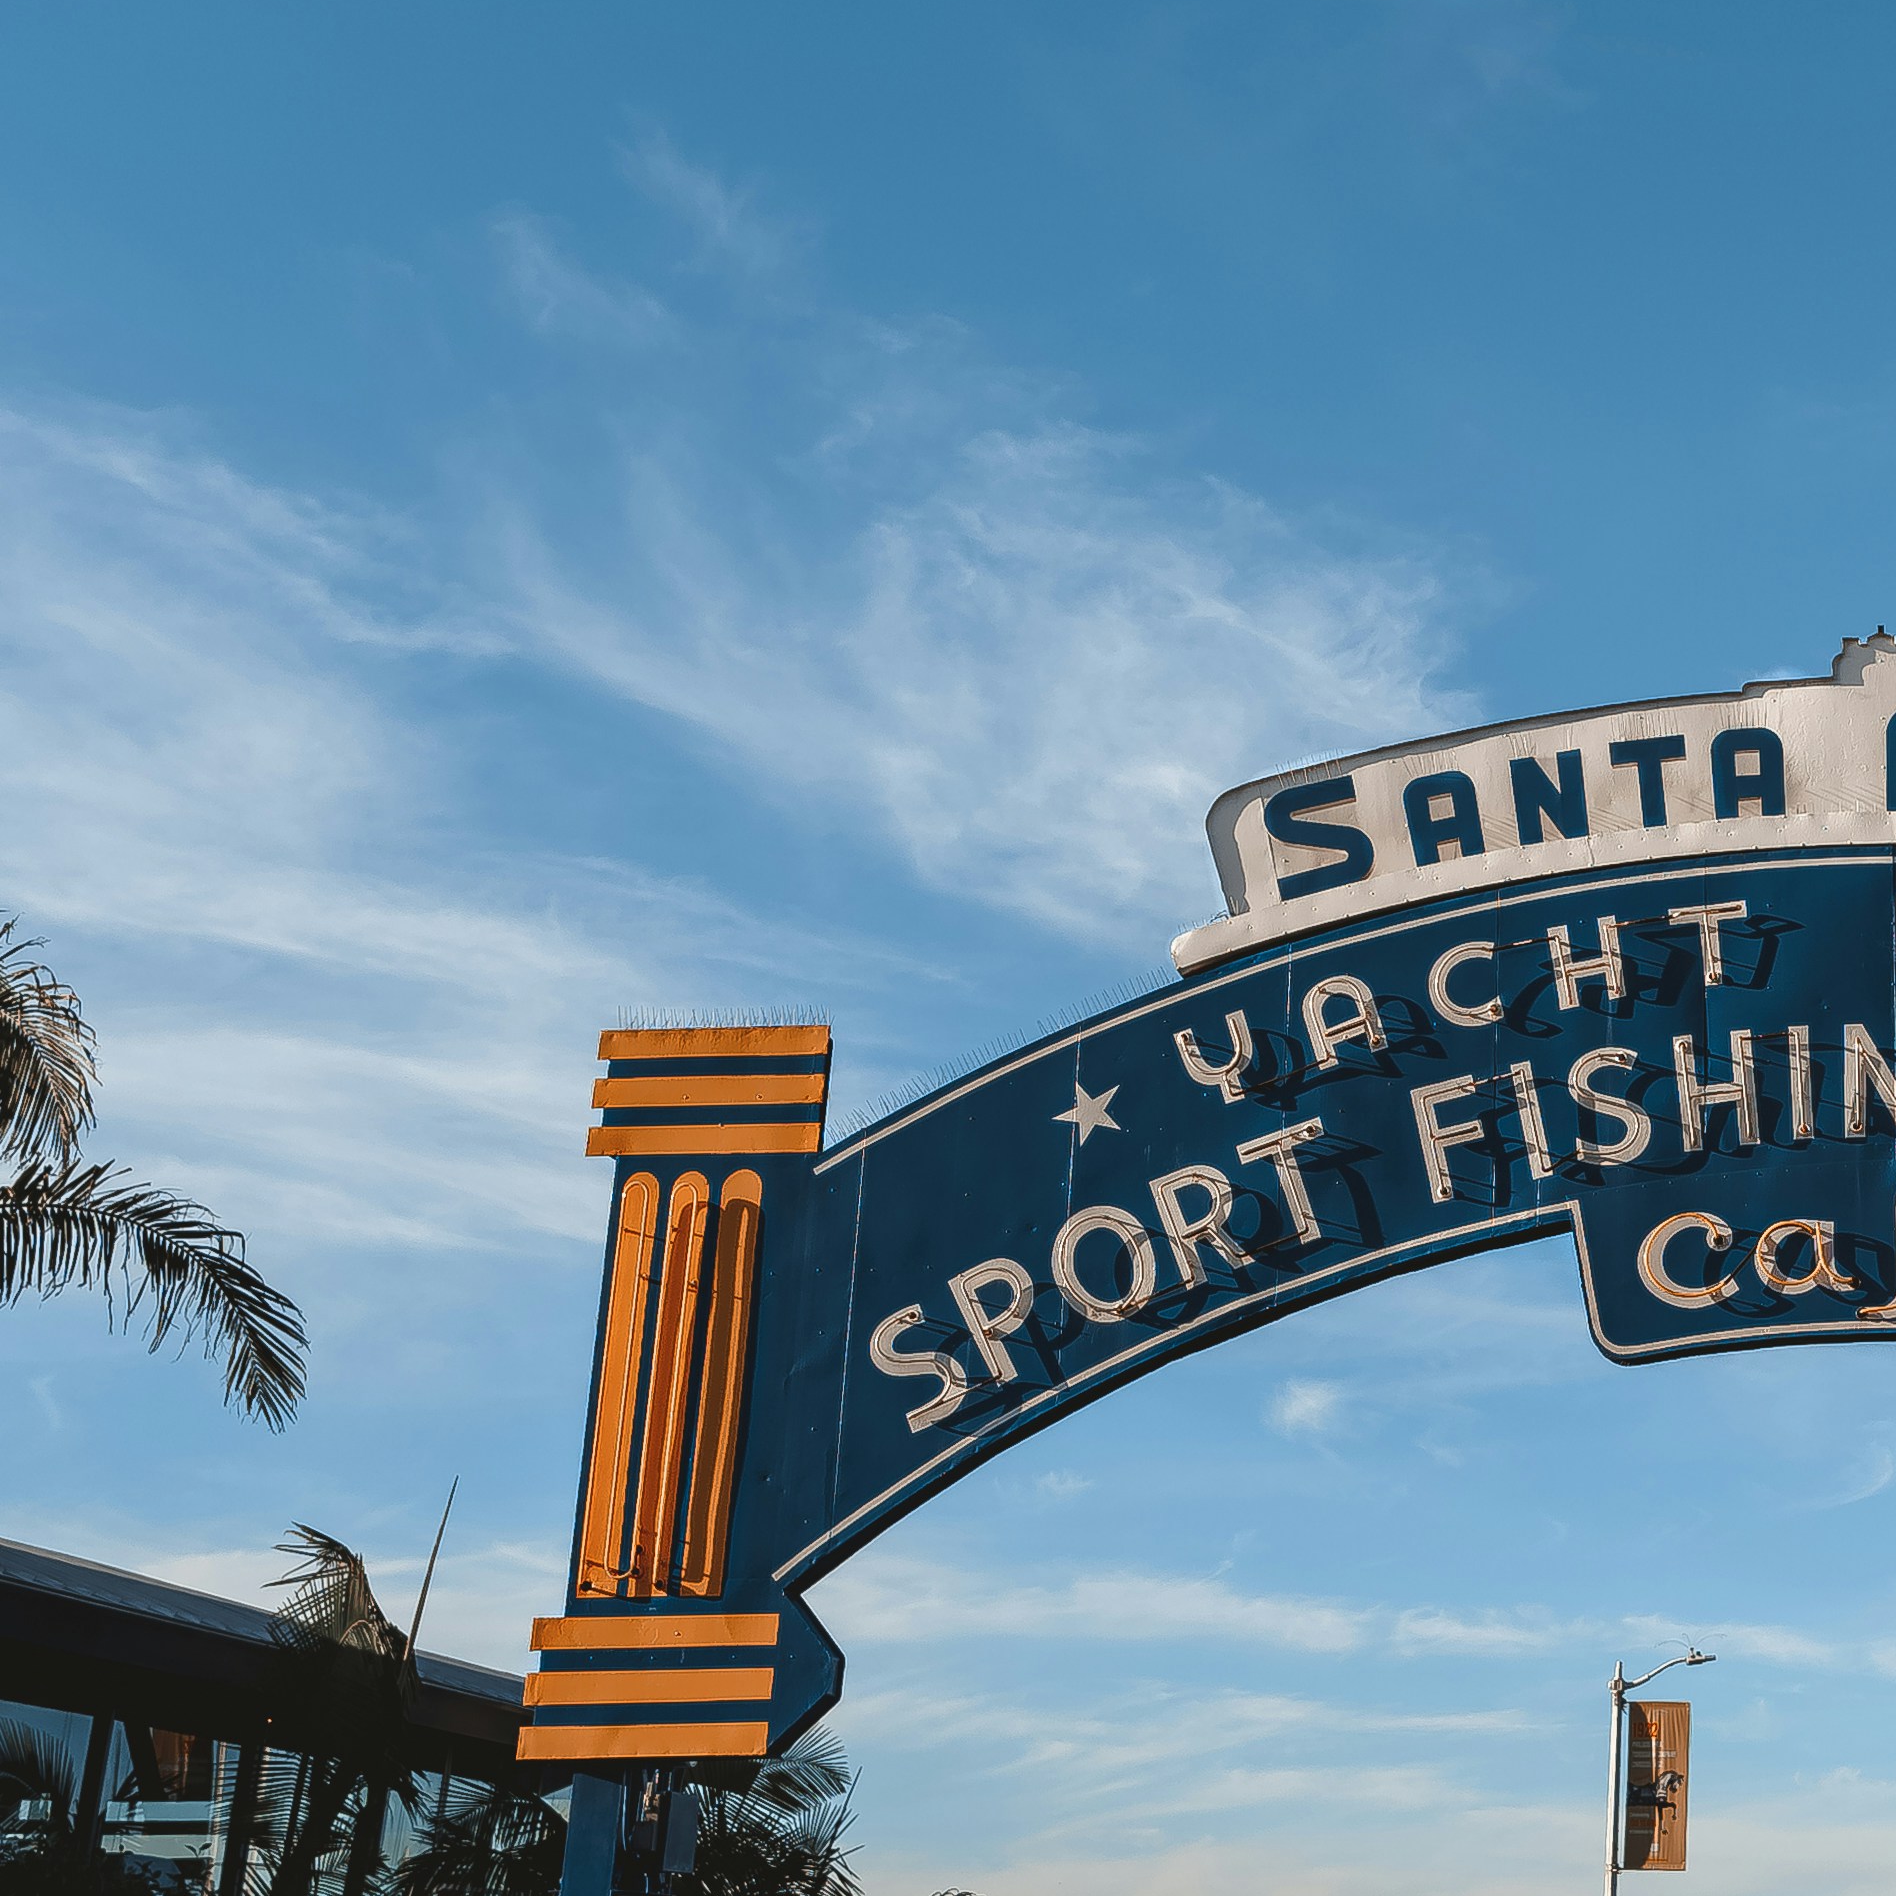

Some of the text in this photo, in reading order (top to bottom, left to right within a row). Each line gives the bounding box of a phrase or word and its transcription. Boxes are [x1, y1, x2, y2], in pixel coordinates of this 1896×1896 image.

[1264, 727, 1787, 901] SANTA
[1173, 901, 1748, 1104] YACHT
[870, 1117, 1325, 1434] SPORT
